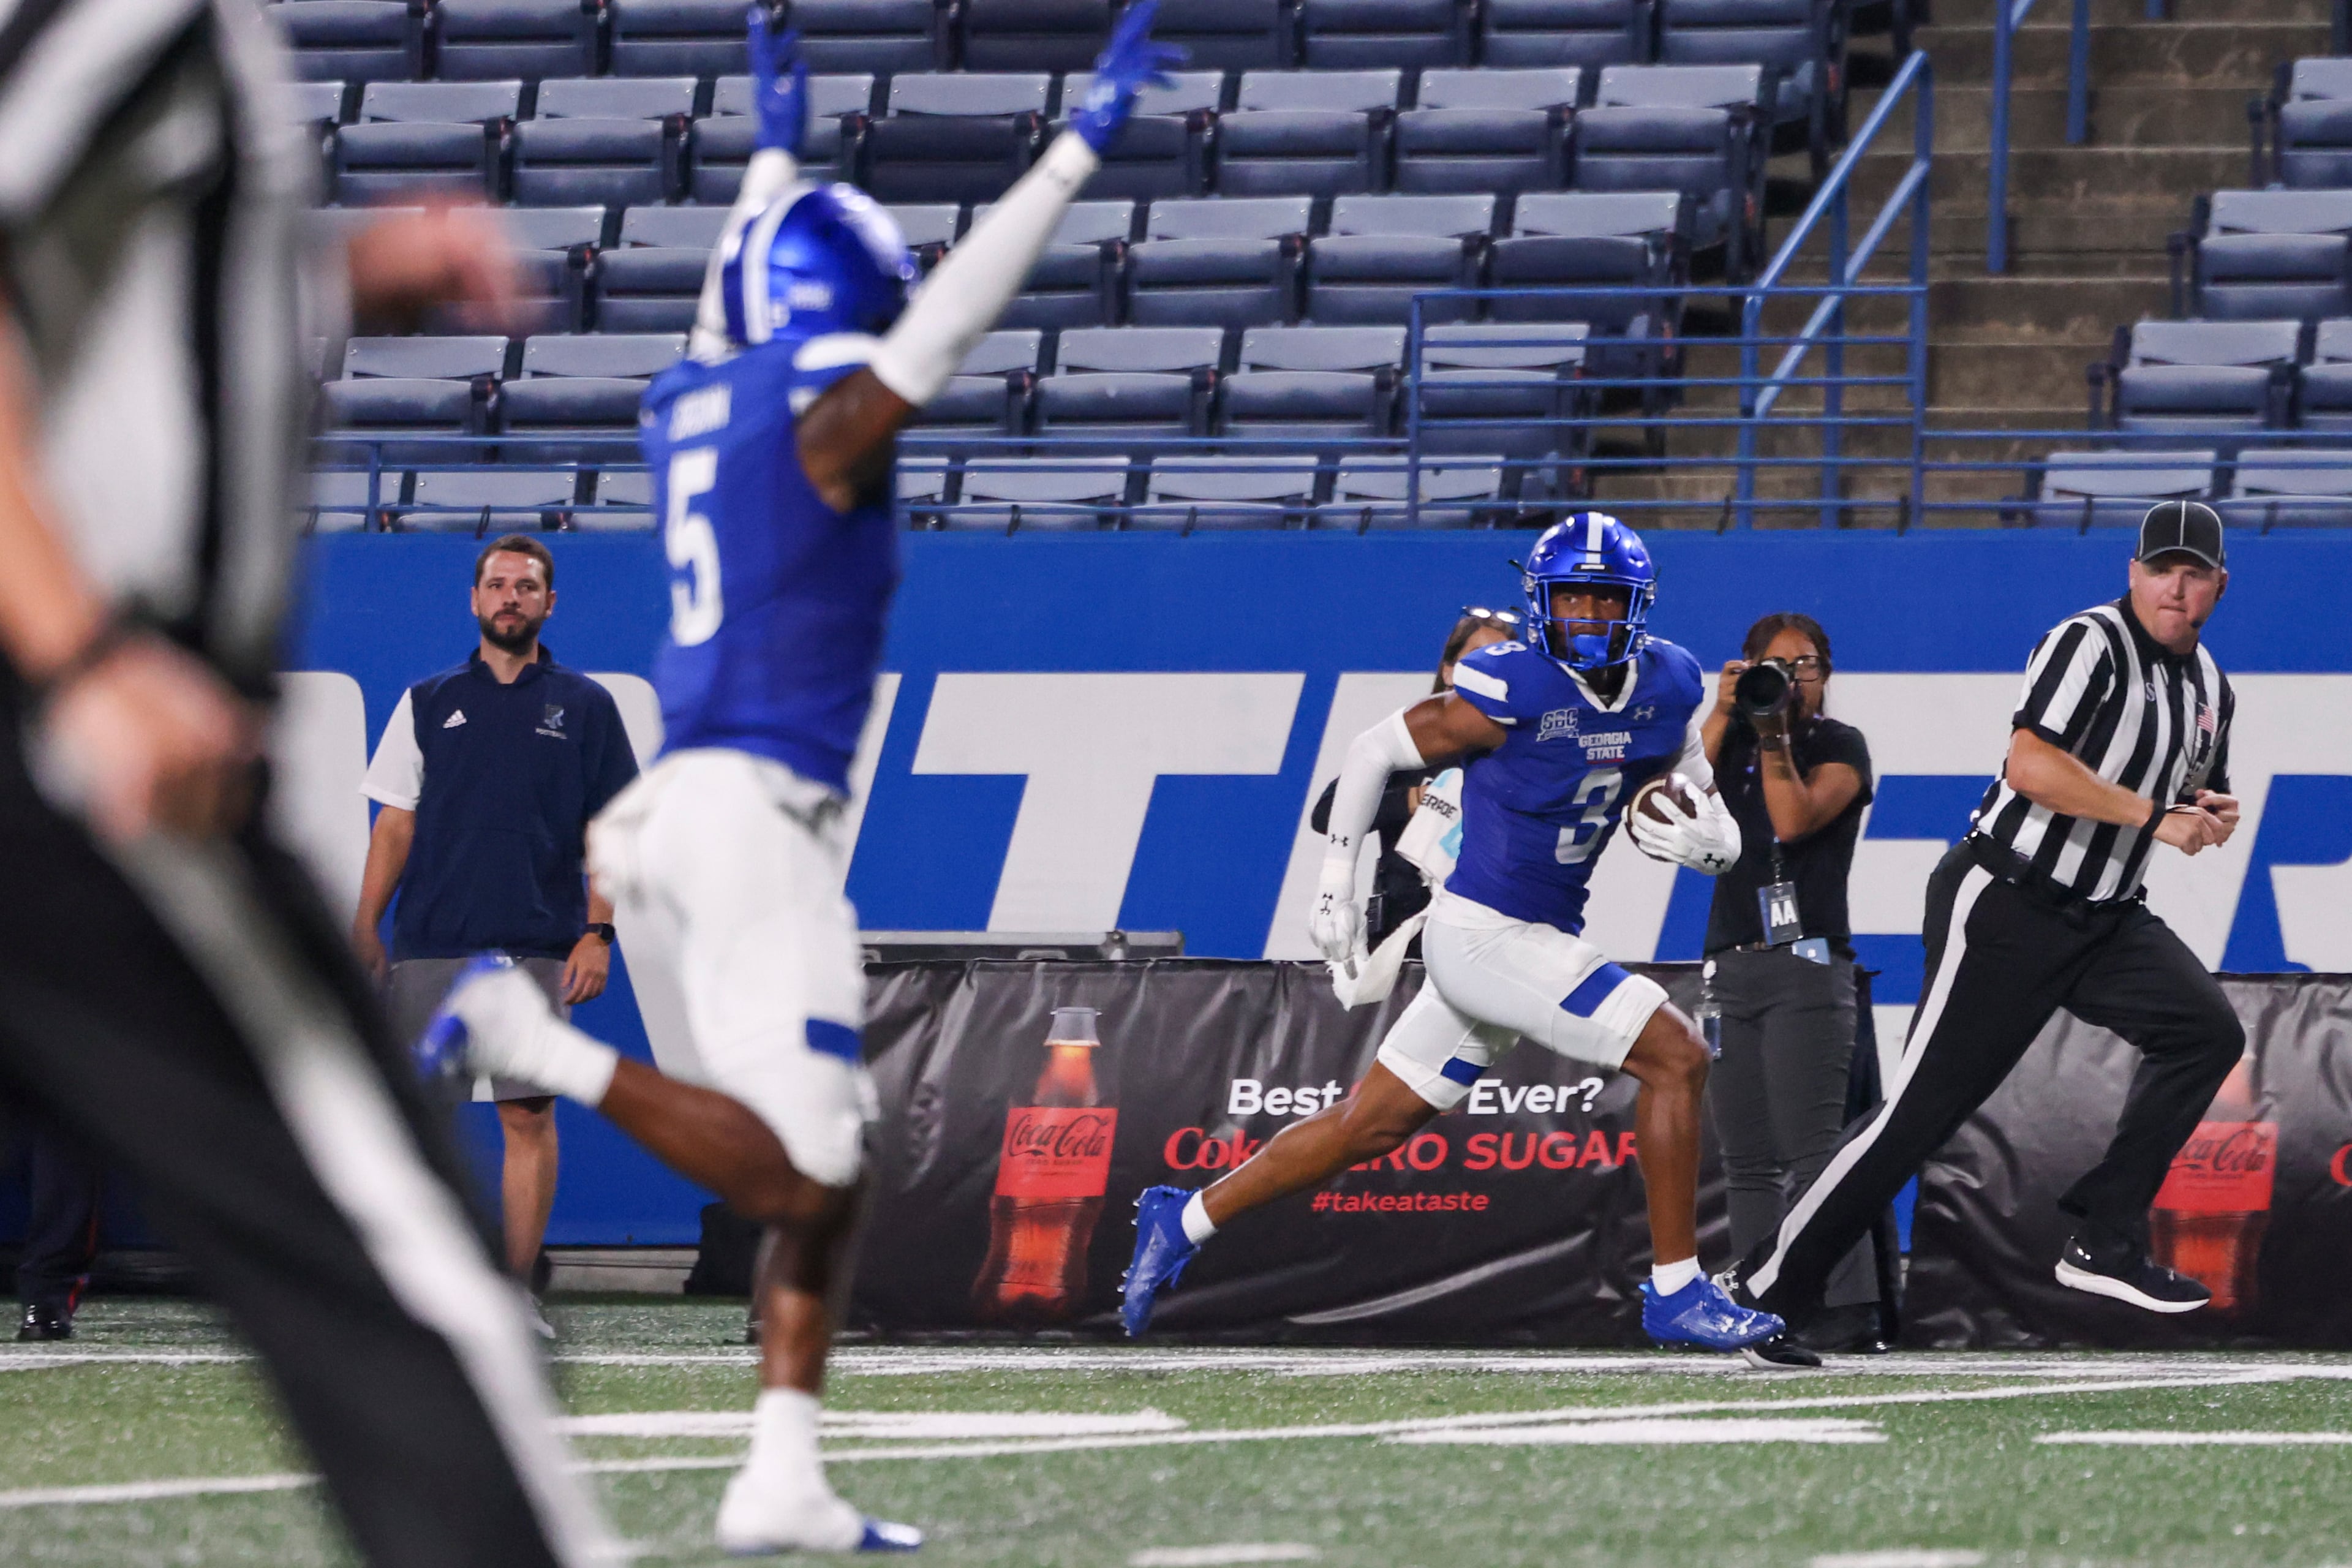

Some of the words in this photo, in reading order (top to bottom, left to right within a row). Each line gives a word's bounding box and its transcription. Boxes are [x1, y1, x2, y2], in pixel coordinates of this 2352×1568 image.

[666, 446, 724, 646] 5
[1578, 731, 1632, 748] GEORGIA
[1586, 745, 1625, 760] STATE
[1555, 768, 1623, 864] 3
[1771, 899, 1798, 927] AA
[1227, 1079, 1343, 1116] Best
[1468, 1077, 1604, 1115] Ever?
[1164, 1127, 1268, 1170] Cok
[1311, 1189, 1490, 1213] #takeataste
